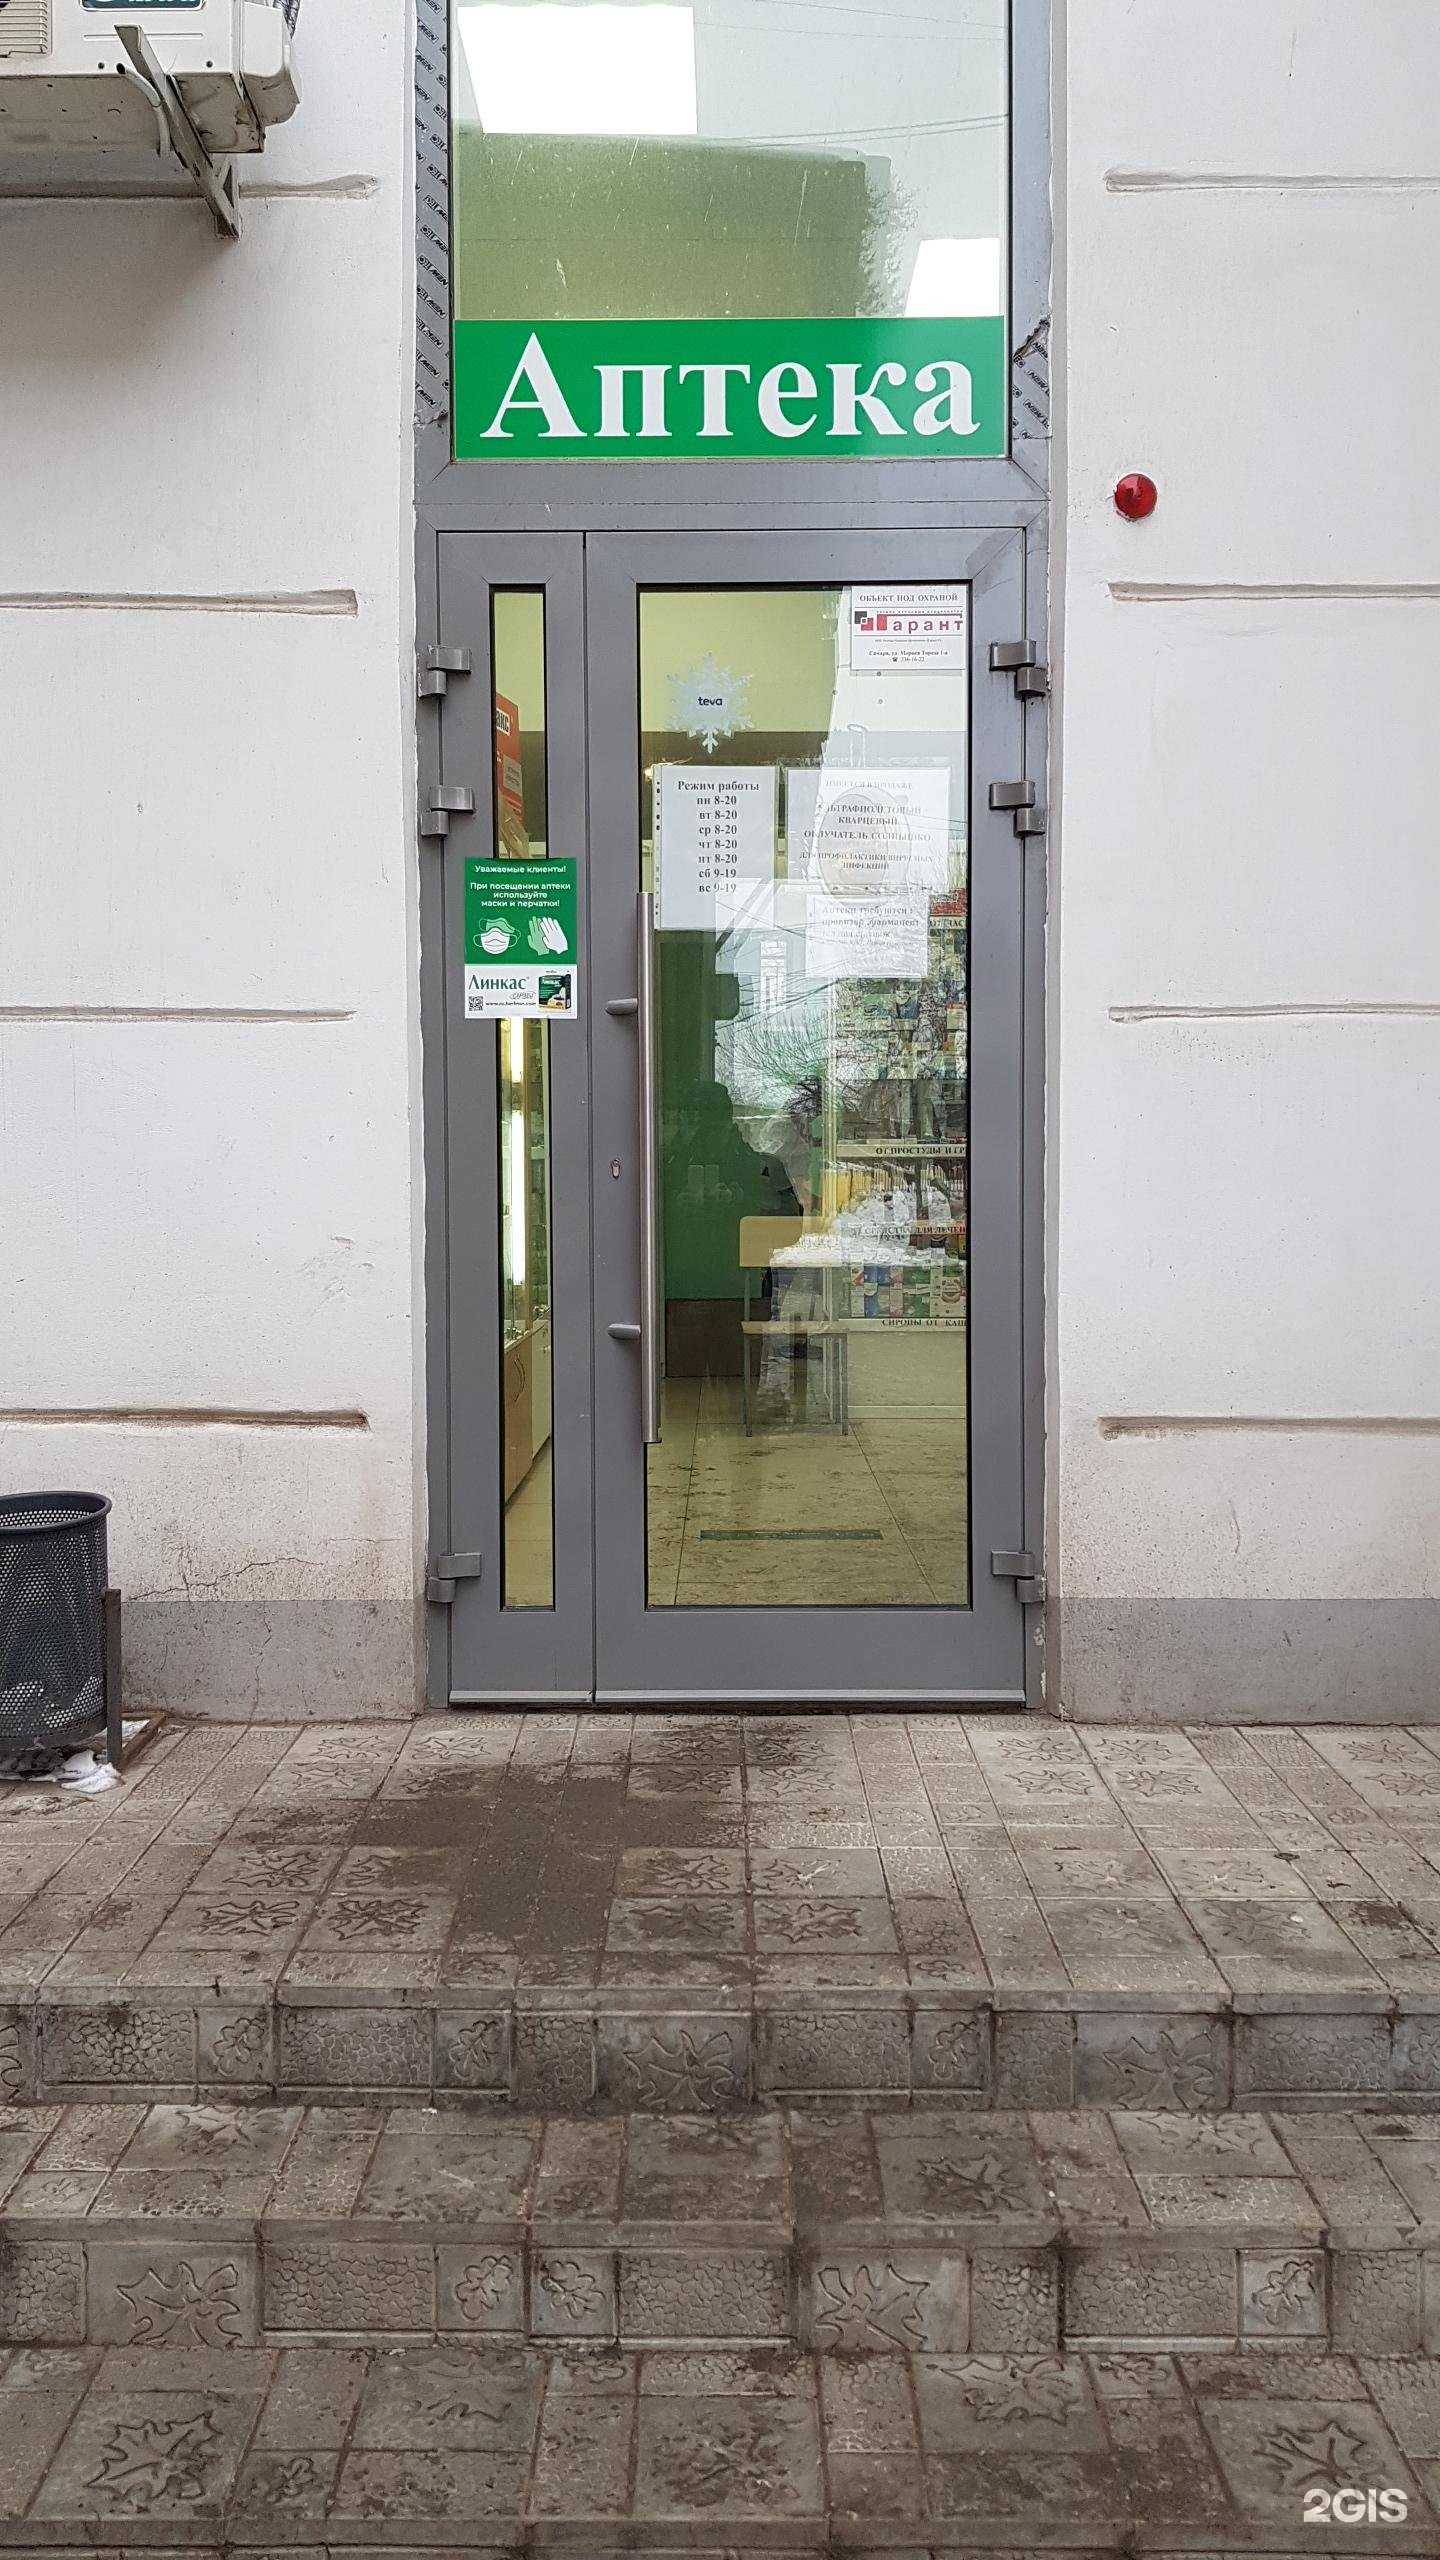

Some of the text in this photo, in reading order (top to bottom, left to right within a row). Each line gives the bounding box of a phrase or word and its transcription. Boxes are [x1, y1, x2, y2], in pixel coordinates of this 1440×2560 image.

[480, 332, 981, 438] Аптека
[860, 593, 959, 603] ОБЪЕКТ ПОД ОХРАНОЙ
[698, 697, 722, 706] teva
[678, 780, 760, 793] Режим работы
[697, 795, 737, 805] пн 8-20
[699, 810, 738, 820] вт 8-20
[699, 825, 738, 836] ср 8-20
[699, 839, 738, 849] чт 8-20
[715, 854, 738, 864] 8-20
[474, 865, 567, 873] Уважаемые клиенты!
[699, 868, 737, 878] сб 9-19
[470, 882, 488, 890] При
[699, 883, 737, 893] вс 9-19
[493, 891, 548, 900] используйте
[517, 900, 560, 909] перчатки!
[468, 975, 526, 990] Линкас
[889, 1146, 940, 1155] ПРОСТУДЫ
[881, 1319, 921, 1327] СИРОПЫ
